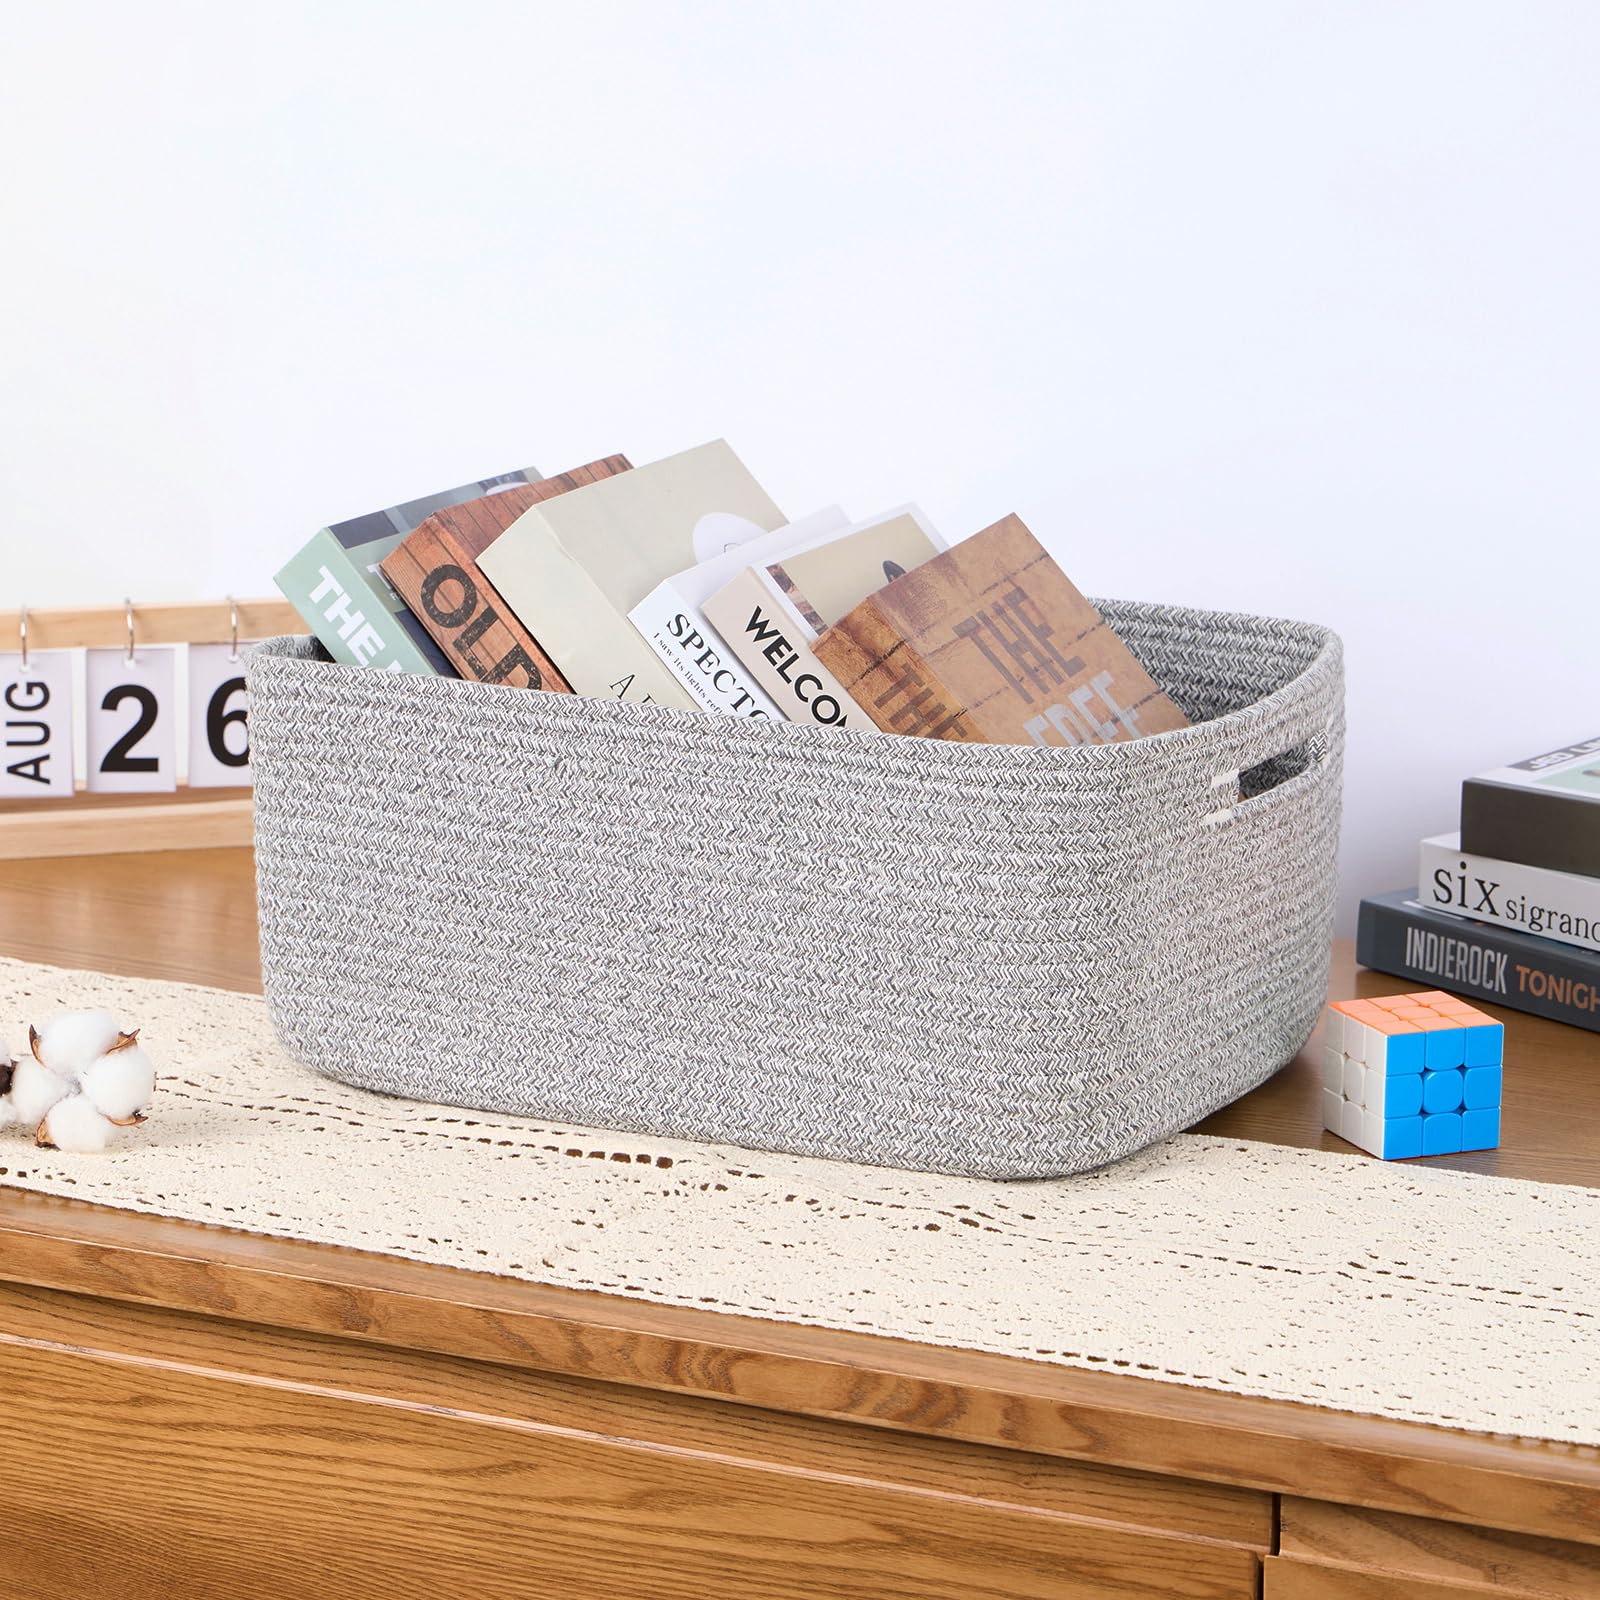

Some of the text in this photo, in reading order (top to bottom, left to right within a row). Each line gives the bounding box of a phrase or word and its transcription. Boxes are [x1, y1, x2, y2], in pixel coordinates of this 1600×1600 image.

[309, 565, 386, 667] THE
[745, 606, 848, 728] WELCO
[953, 584, 1087, 704] THE
[658, 639, 673, 657] saw
[684, 671, 707, 698] lights
[5, 681, 50, 785] AUG
[1405, 926, 1509, 995] INDIEROCK
